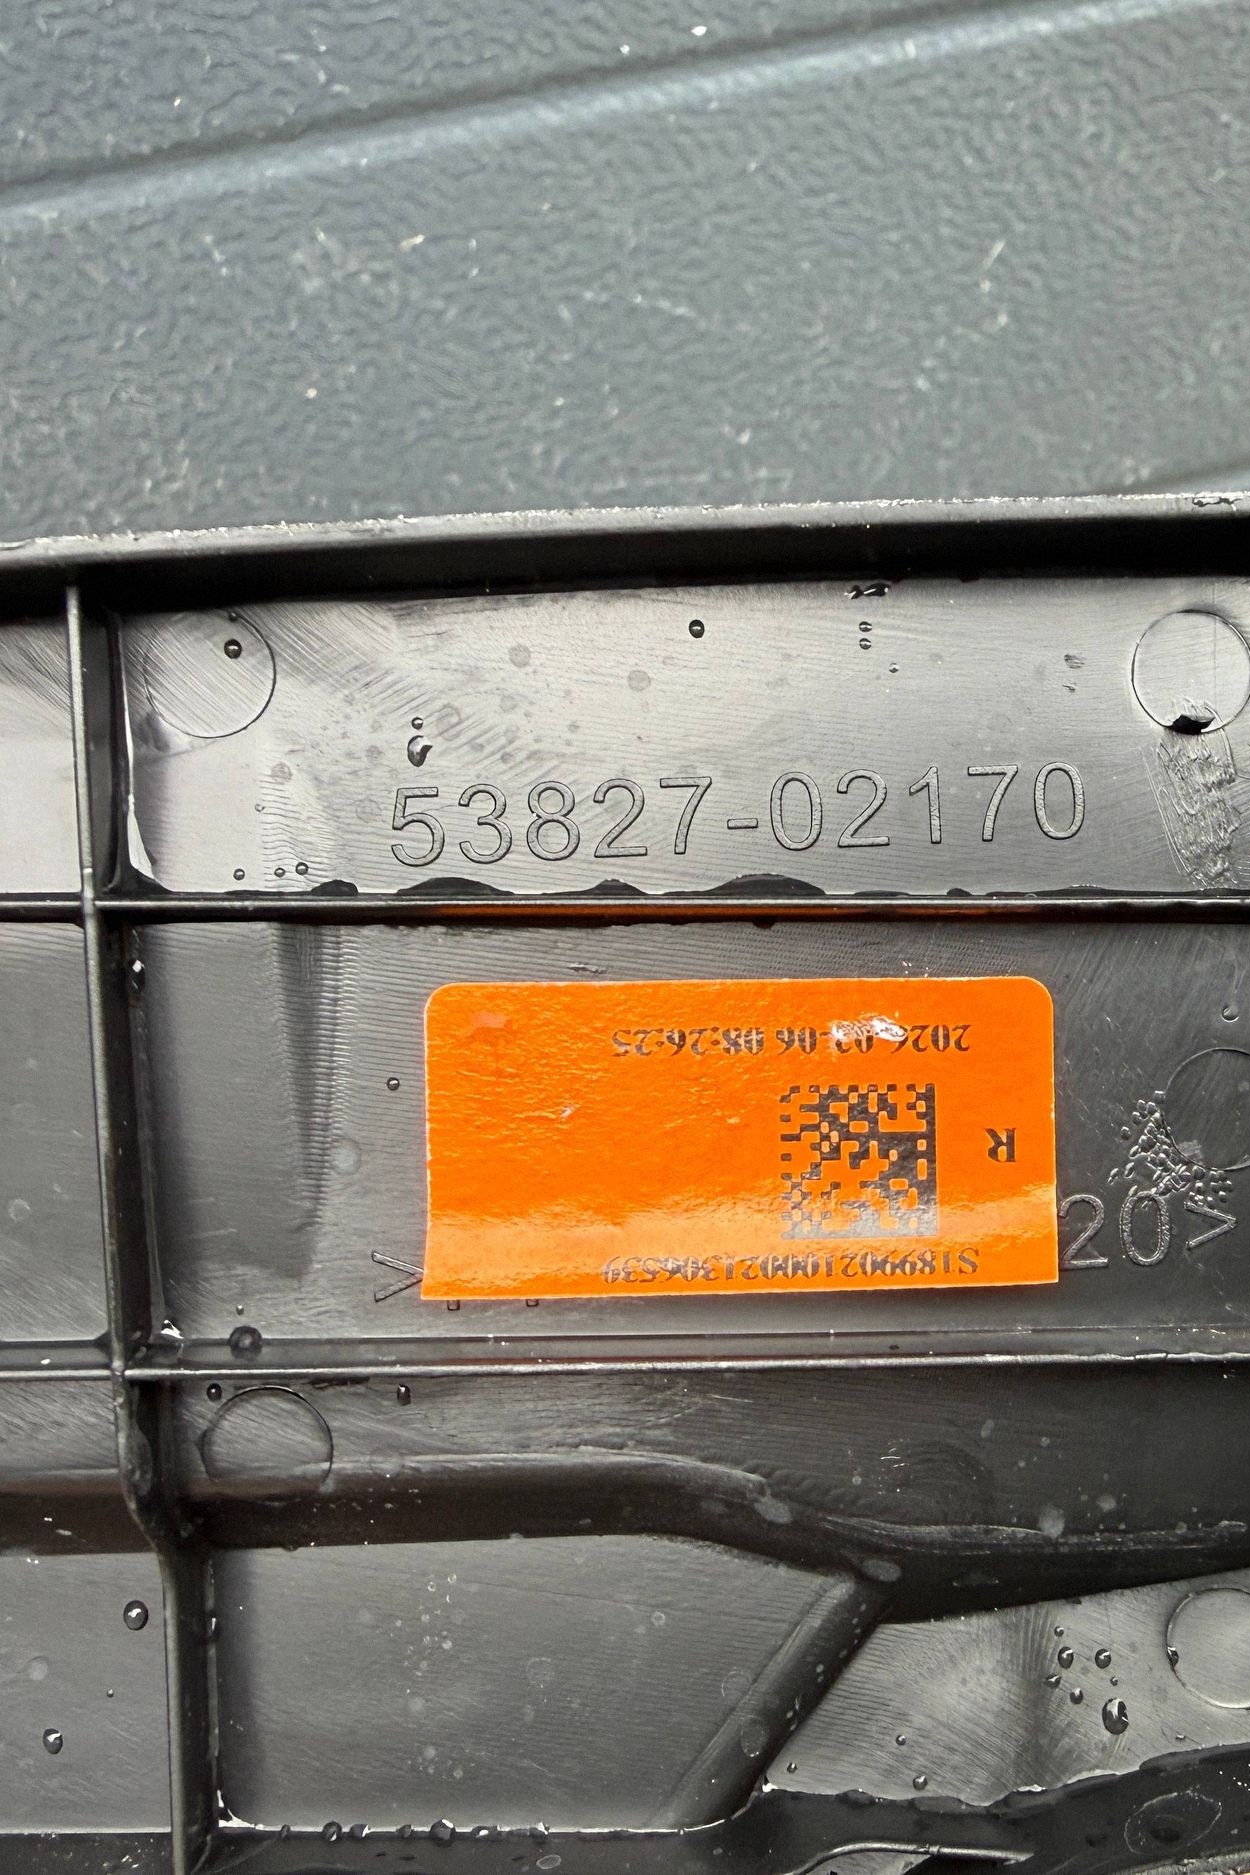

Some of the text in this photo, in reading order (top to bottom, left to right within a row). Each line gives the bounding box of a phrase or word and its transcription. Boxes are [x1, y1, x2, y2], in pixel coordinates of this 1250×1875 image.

[390, 761, 1087, 868] 53827-02170
[611, 1025, 764, 1057] 08:26:25
[984, 1128, 1018, 1163] R
